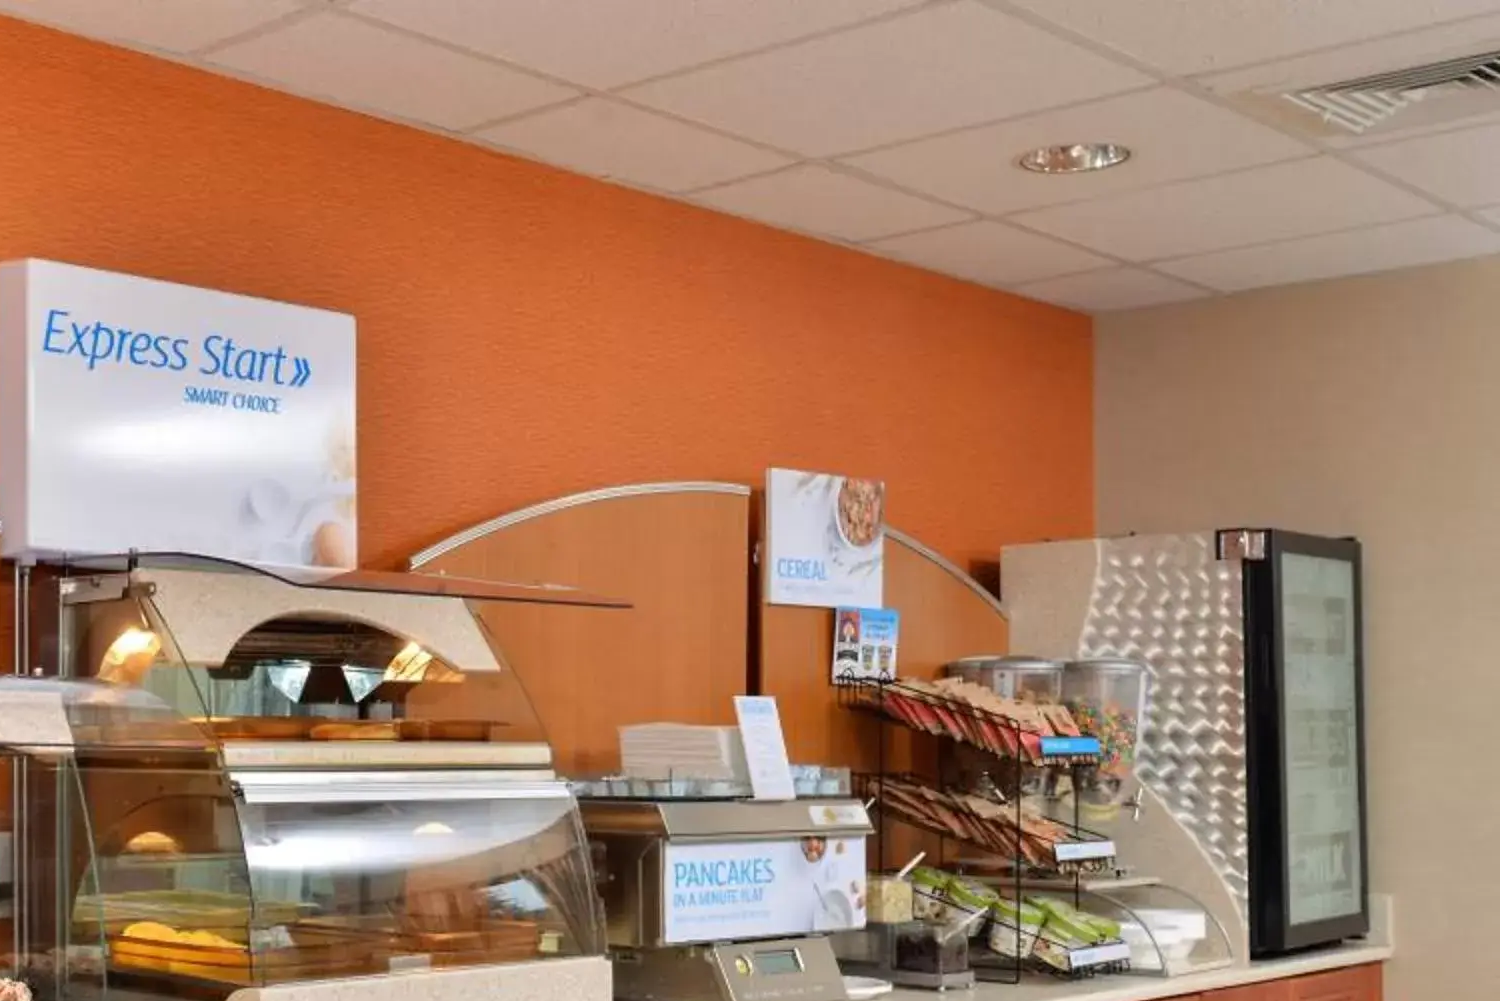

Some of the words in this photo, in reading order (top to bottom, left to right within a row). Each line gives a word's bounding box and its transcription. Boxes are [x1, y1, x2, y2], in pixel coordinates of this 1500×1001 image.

[43, 309, 189, 371] Express
[199, 335, 287, 386] Start
[183, 386, 229, 408] SMART
[233, 393, 282, 414] CHOICE
[777, 557, 828, 581] CEREAL
[674, 858, 776, 888] PANCAKES
